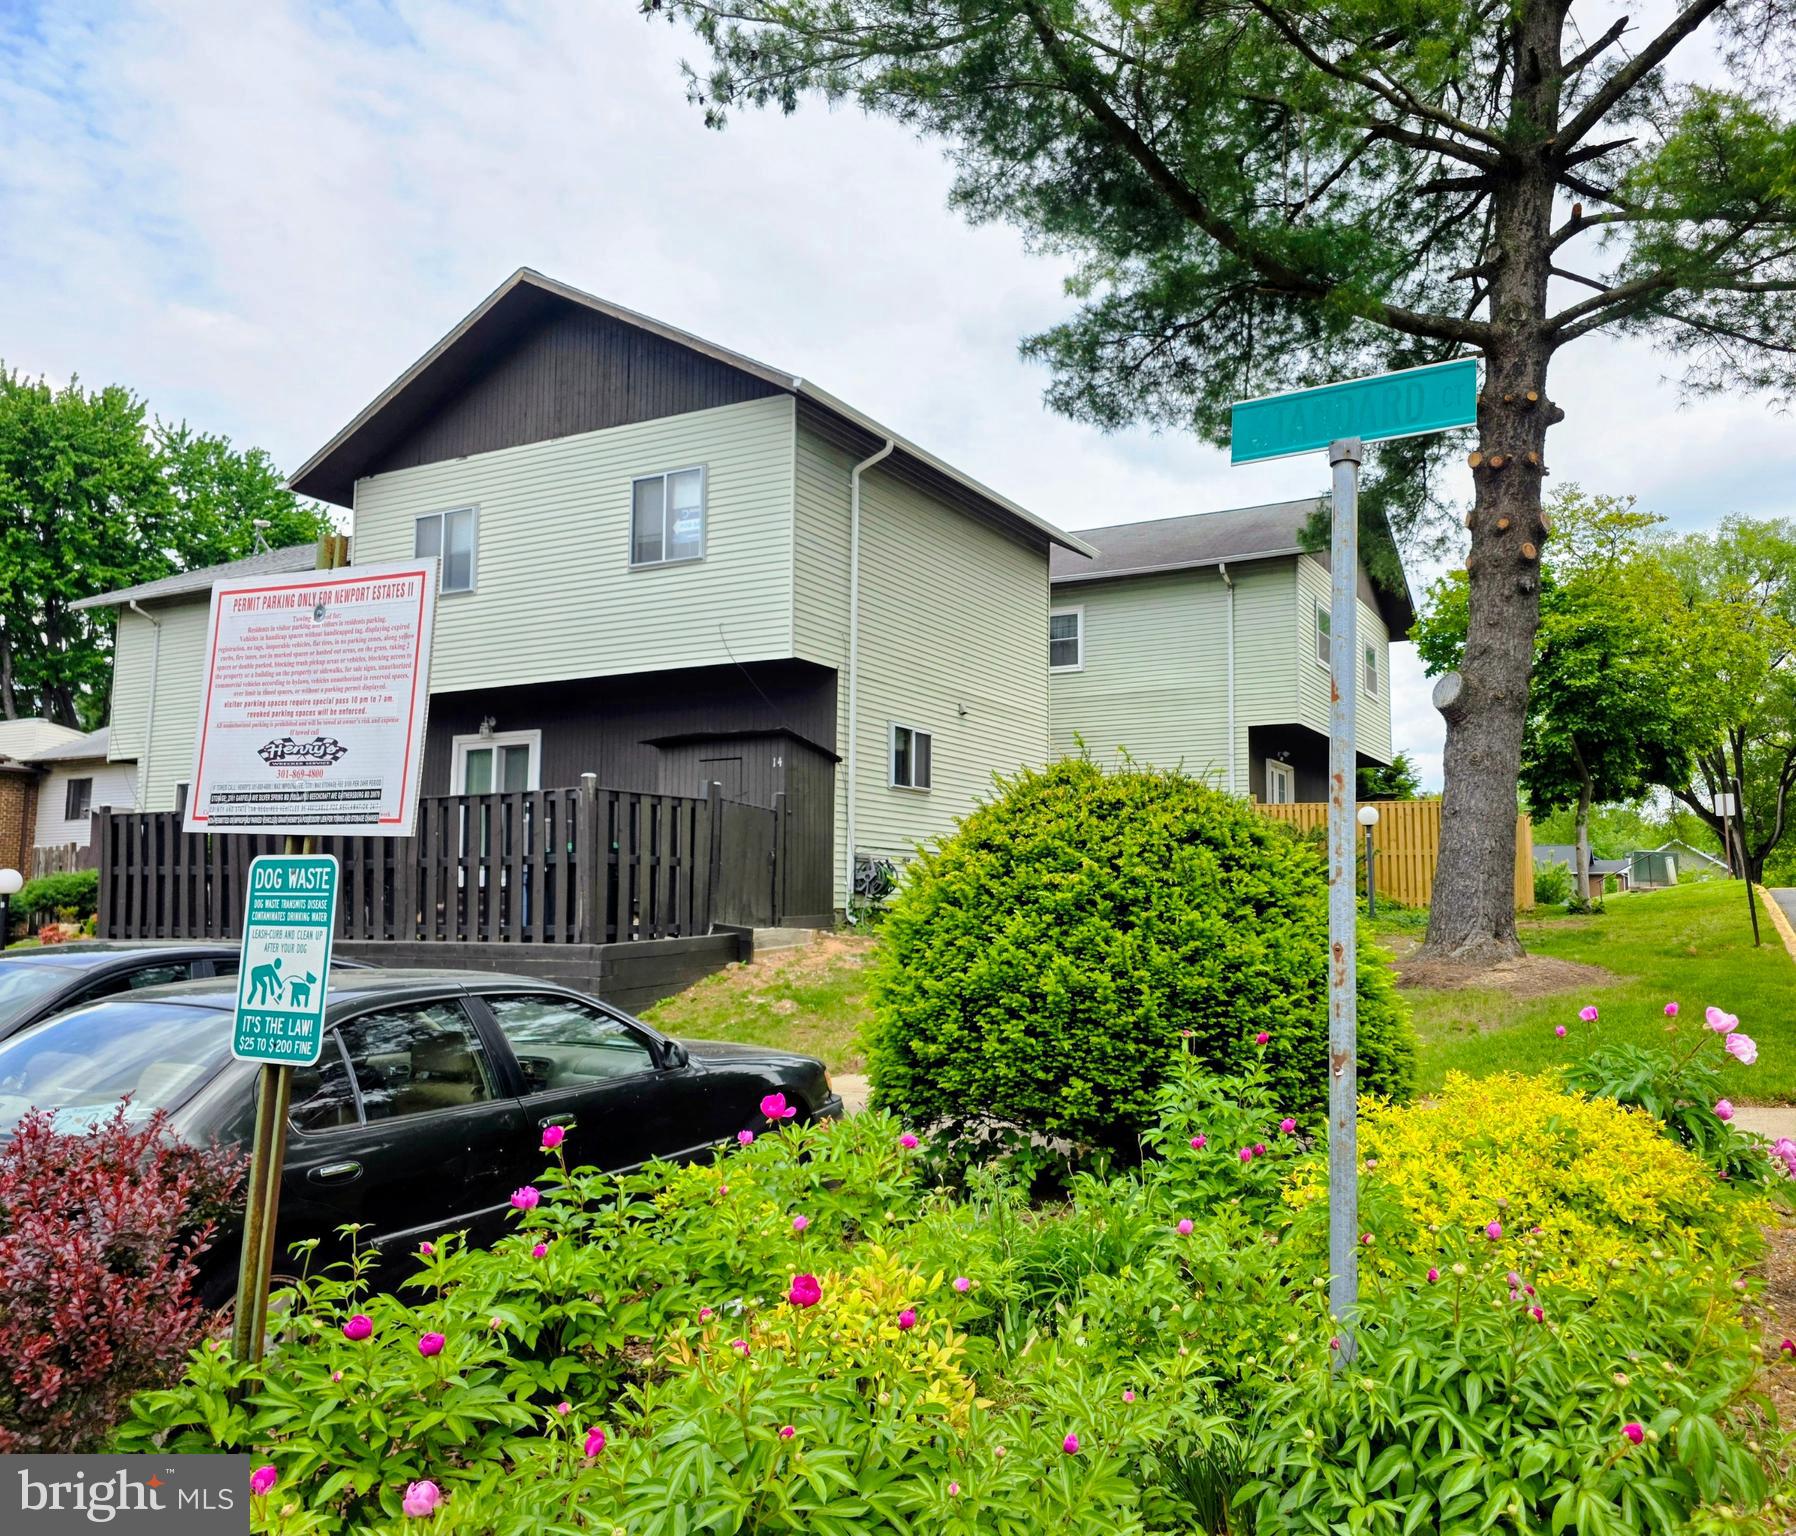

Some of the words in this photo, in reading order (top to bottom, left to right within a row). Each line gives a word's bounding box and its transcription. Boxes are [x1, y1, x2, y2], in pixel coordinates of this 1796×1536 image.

[233, 597, 260, 612] PERMIT
[262, 594, 295, 610] PARKING
[297, 592, 317, 608] ONLY
[319, 591, 332, 605] FOR
[334, 587, 370, 604] NEWPORT
[372, 583, 406, 600] ESTATES
[292, 615, 312, 623] Towing
[292, 622, 311, 631] parking
[366, 616, 386, 625] parking.
[265, 633, 287, 642] handicap
[323, 627, 354, 638] handicapped
[354, 627, 363, 635] tag,
[365, 625, 390, 634] displaying
[391, 623, 410, 632] expired
[244, 700, 266, 709] parking
[290, 698, 311, 707] require
[313, 697, 334, 706] special
[272, 710, 294, 718] parking
[338, 707, 368, 715] enforced.
[264, 743, 337, 758] Henry's
[773, 757, 782, 767] 14
[276, 769, 324, 779] 301-869-4800
[255, 868, 282, 889] DOG
[288, 868, 331, 889] WASTE
[254, 899, 263, 908] DOG
[265, 899, 280, 909] WASTE
[281, 899, 306, 909] TRANSMITS
[308, 899, 327, 909] DISEASE
[252, 912, 285, 921] CONTAMINATES
[287, 912, 310, 922] DRINKING
[311, 912, 328, 922] WATER
[252, 930, 283, 939] LEASH-CURB
[285, 930, 295, 940] AND
[297, 930, 313, 940] CLEAN
[316, 931, 323, 940] UP
[264, 943, 279, 953] AFTER
[281, 944, 295, 953] YOUR
[296, 944, 307, 953] DOG
[243, 1016, 261, 1033] IT'S
[265, 1017, 285, 1035] THE
[288, 1018, 313, 1037] LAW!
[239, 1035, 255, 1051] $25
[257, 1038, 266, 1051] TO
[294, 1041, 313, 1055] FINE
